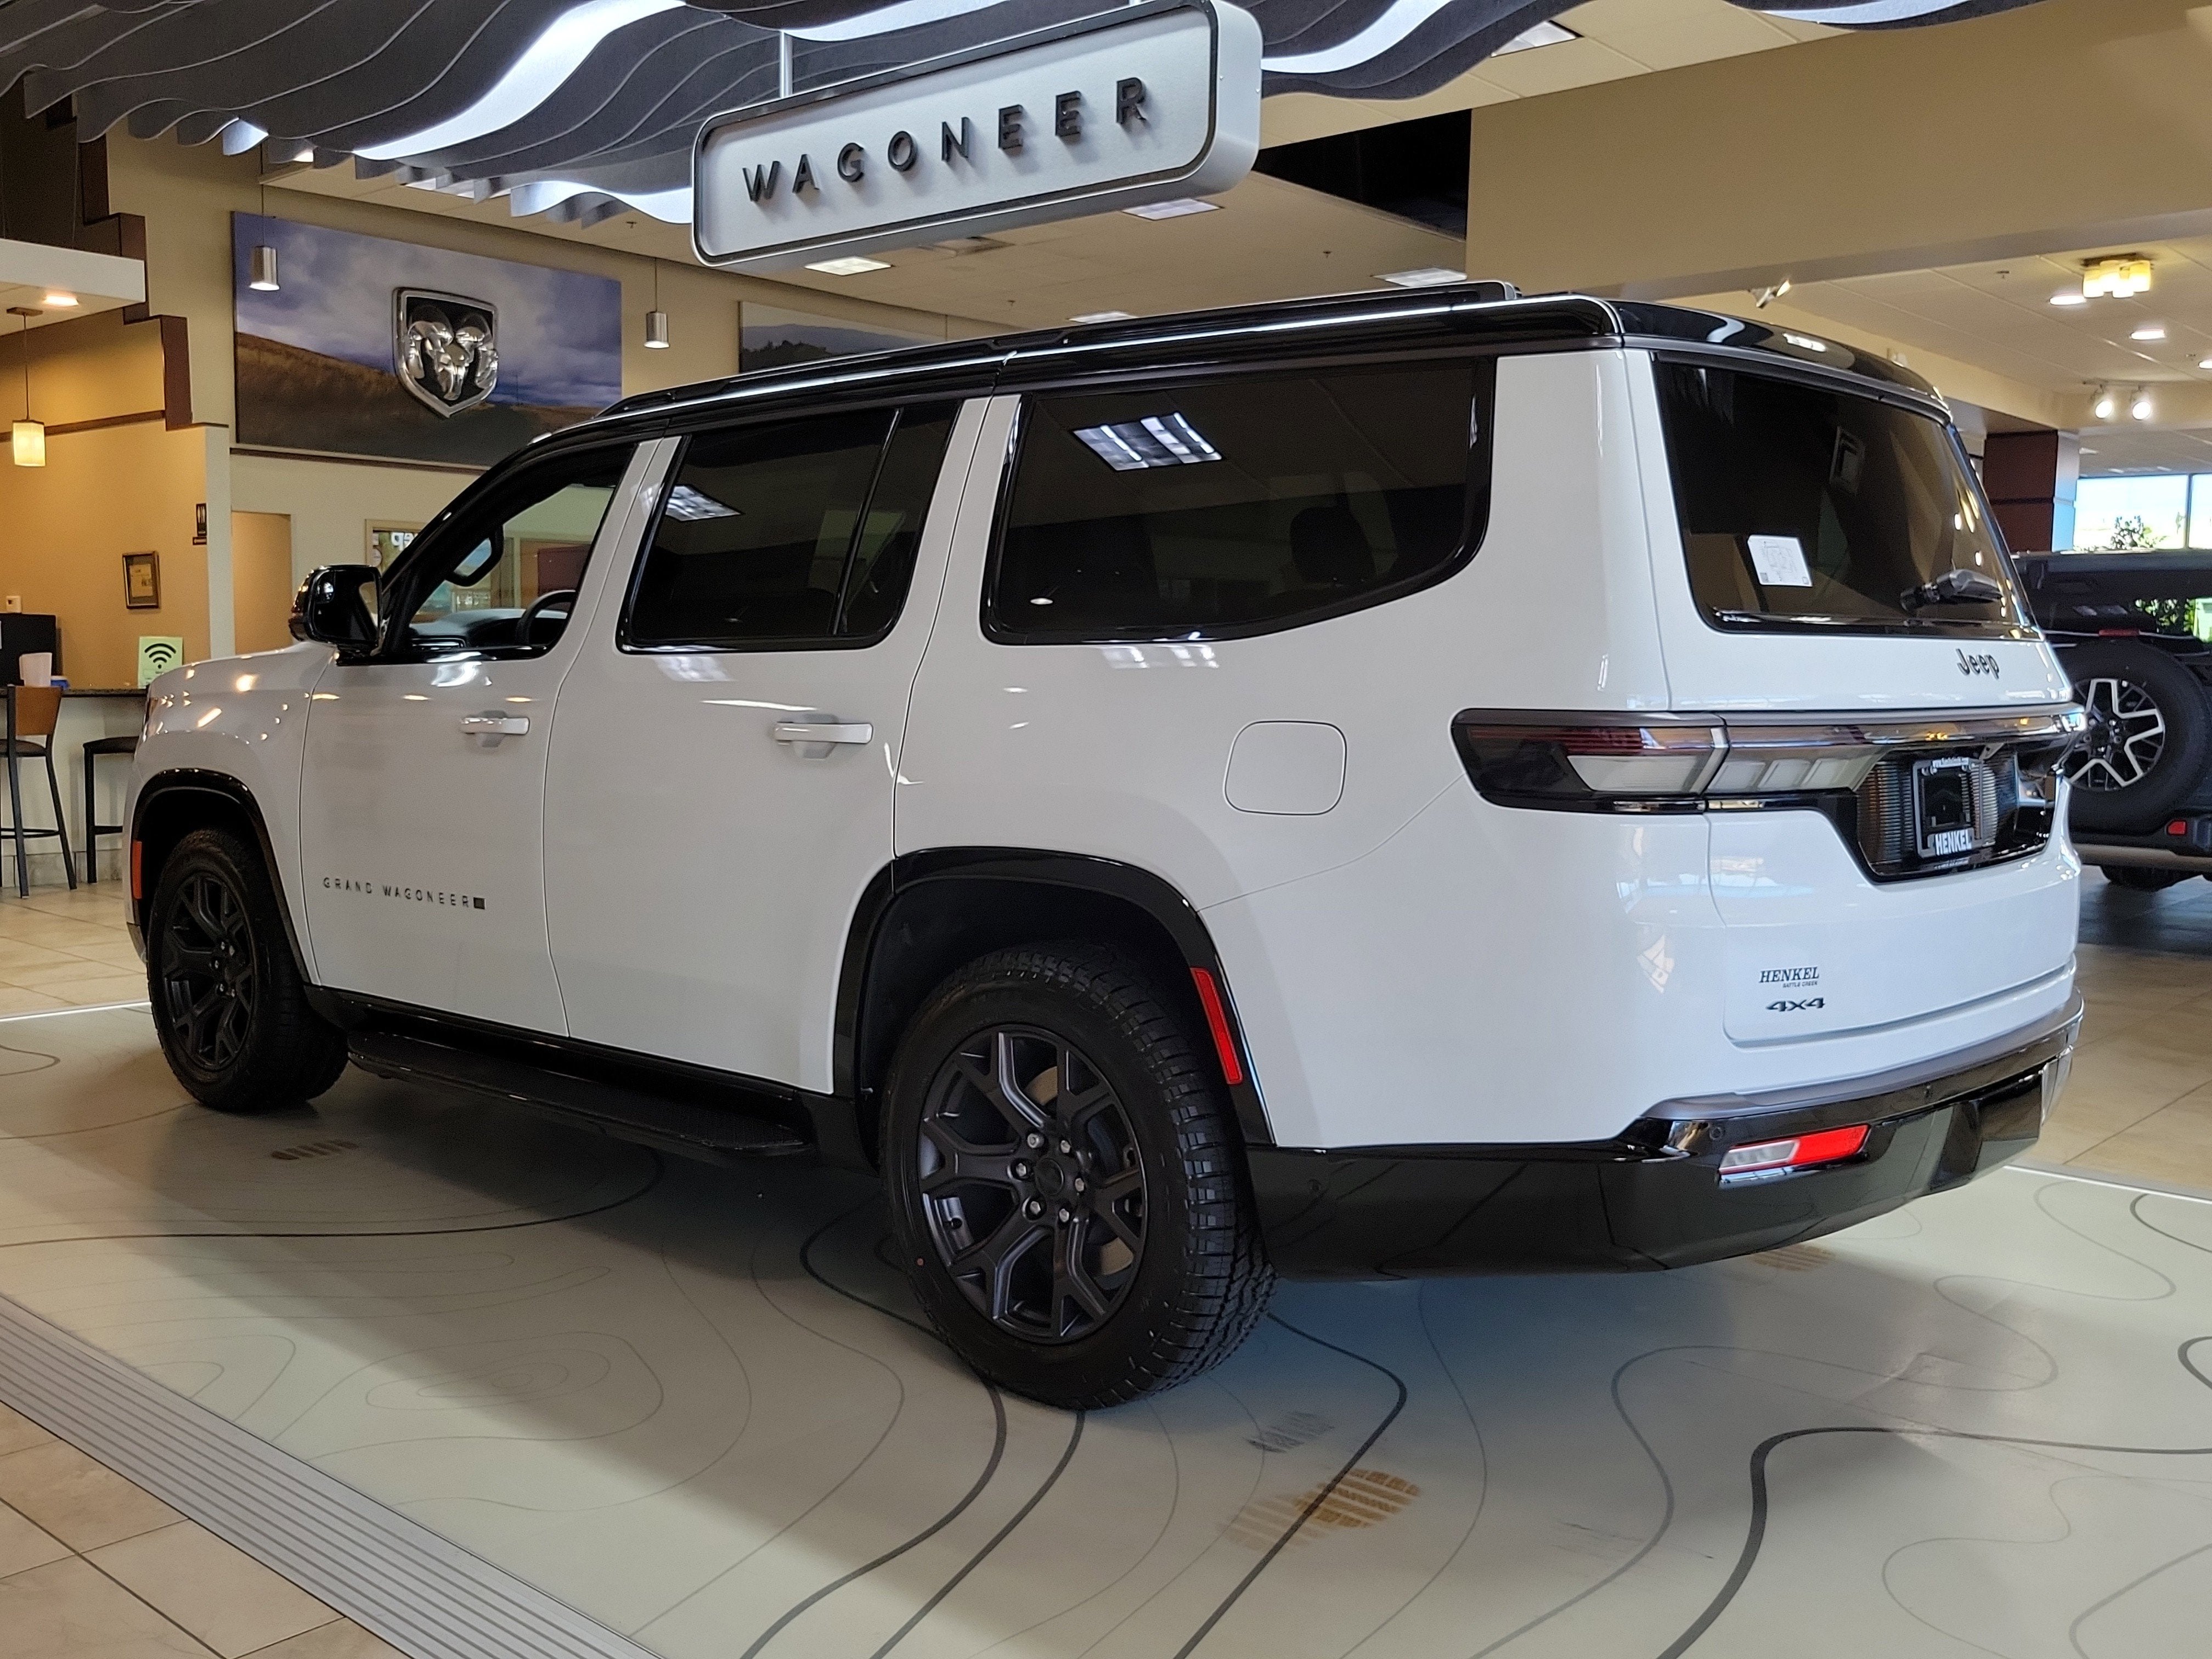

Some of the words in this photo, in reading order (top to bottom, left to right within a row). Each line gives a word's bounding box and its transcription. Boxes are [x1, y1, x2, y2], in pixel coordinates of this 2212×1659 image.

[742, 76, 1147, 202] WAGONEER
[1955, 648, 2000, 680] Jeep
[1934, 828, 1972, 856] HENKEL
[323, 877, 372, 894] GRAND
[382, 885, 469, 908] WAGONEER
[1758, 966, 1820, 983] HENKEL
